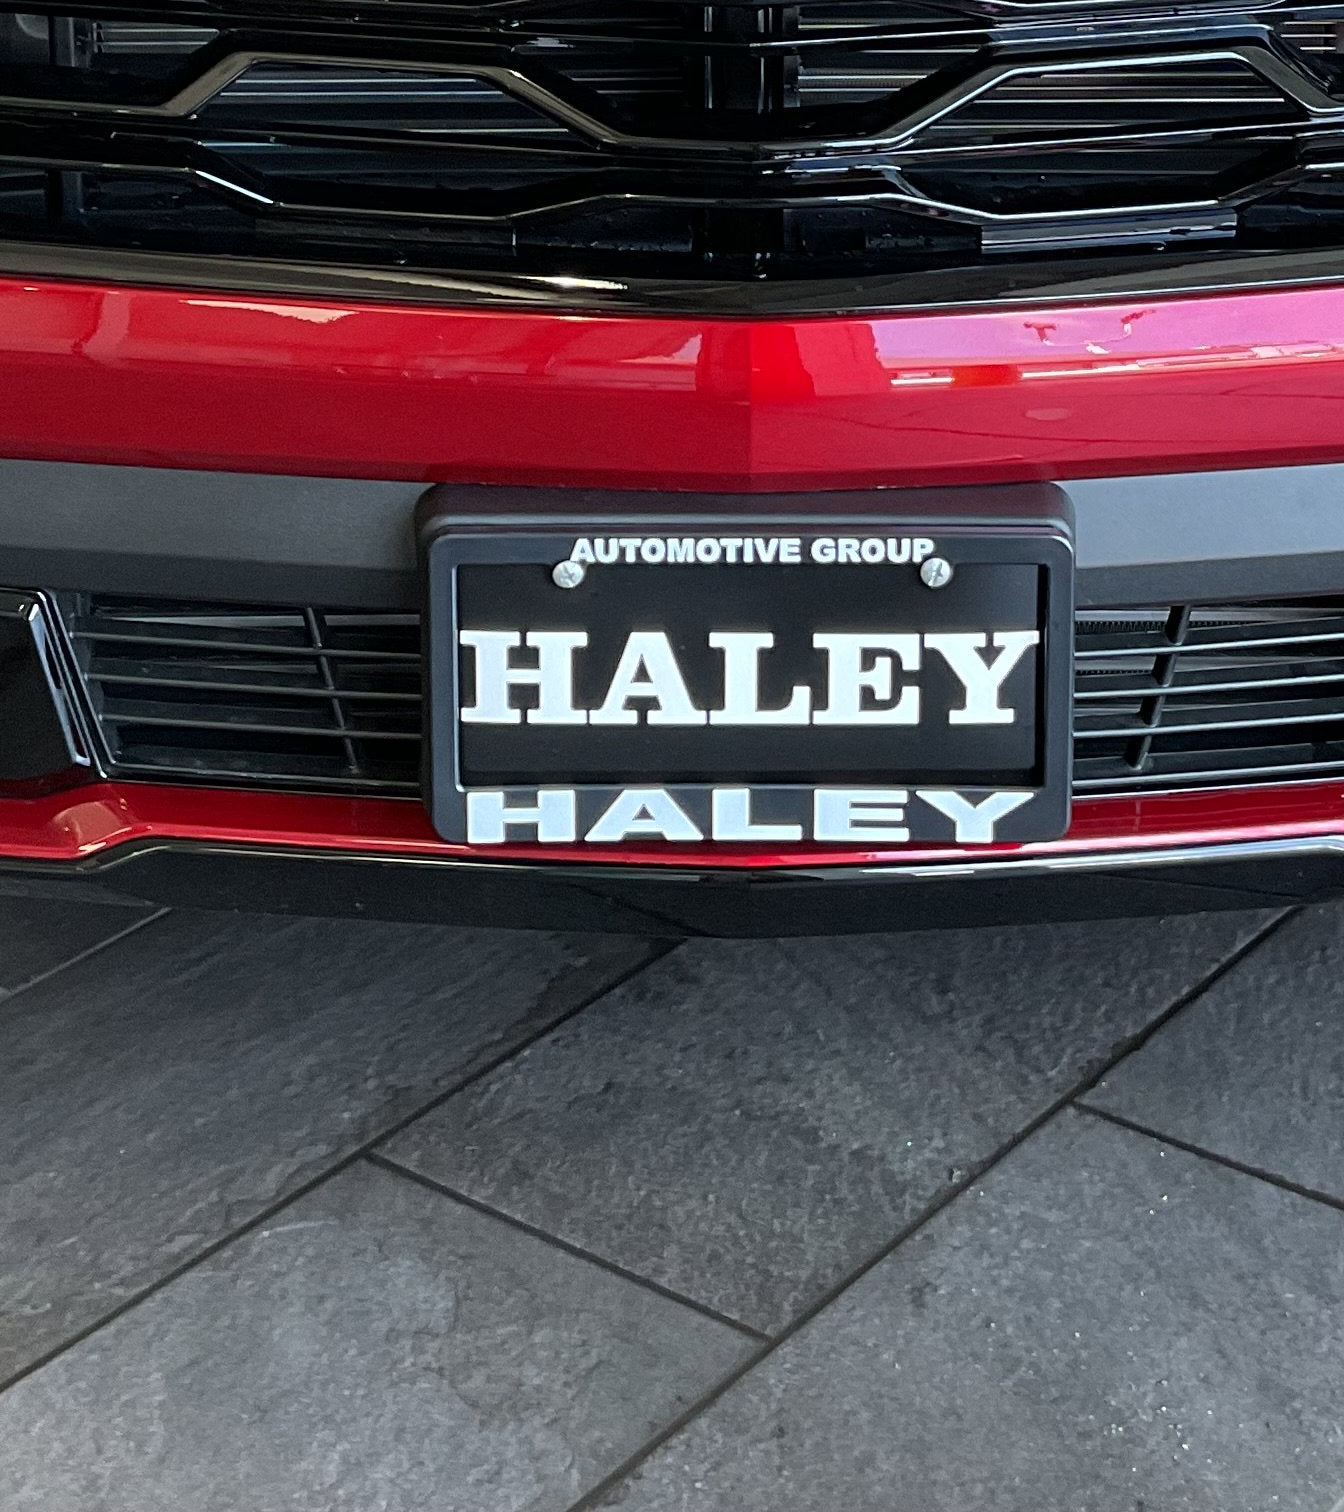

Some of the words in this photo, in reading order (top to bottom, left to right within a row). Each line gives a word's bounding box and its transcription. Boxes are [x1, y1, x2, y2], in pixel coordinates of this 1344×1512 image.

[570, 538, 802, 563] AUTOMOTIVE
[811, 538, 935, 563] GROUP
[459, 630, 1040, 725] HALEY
[466, 789, 1035, 843] HALEY
